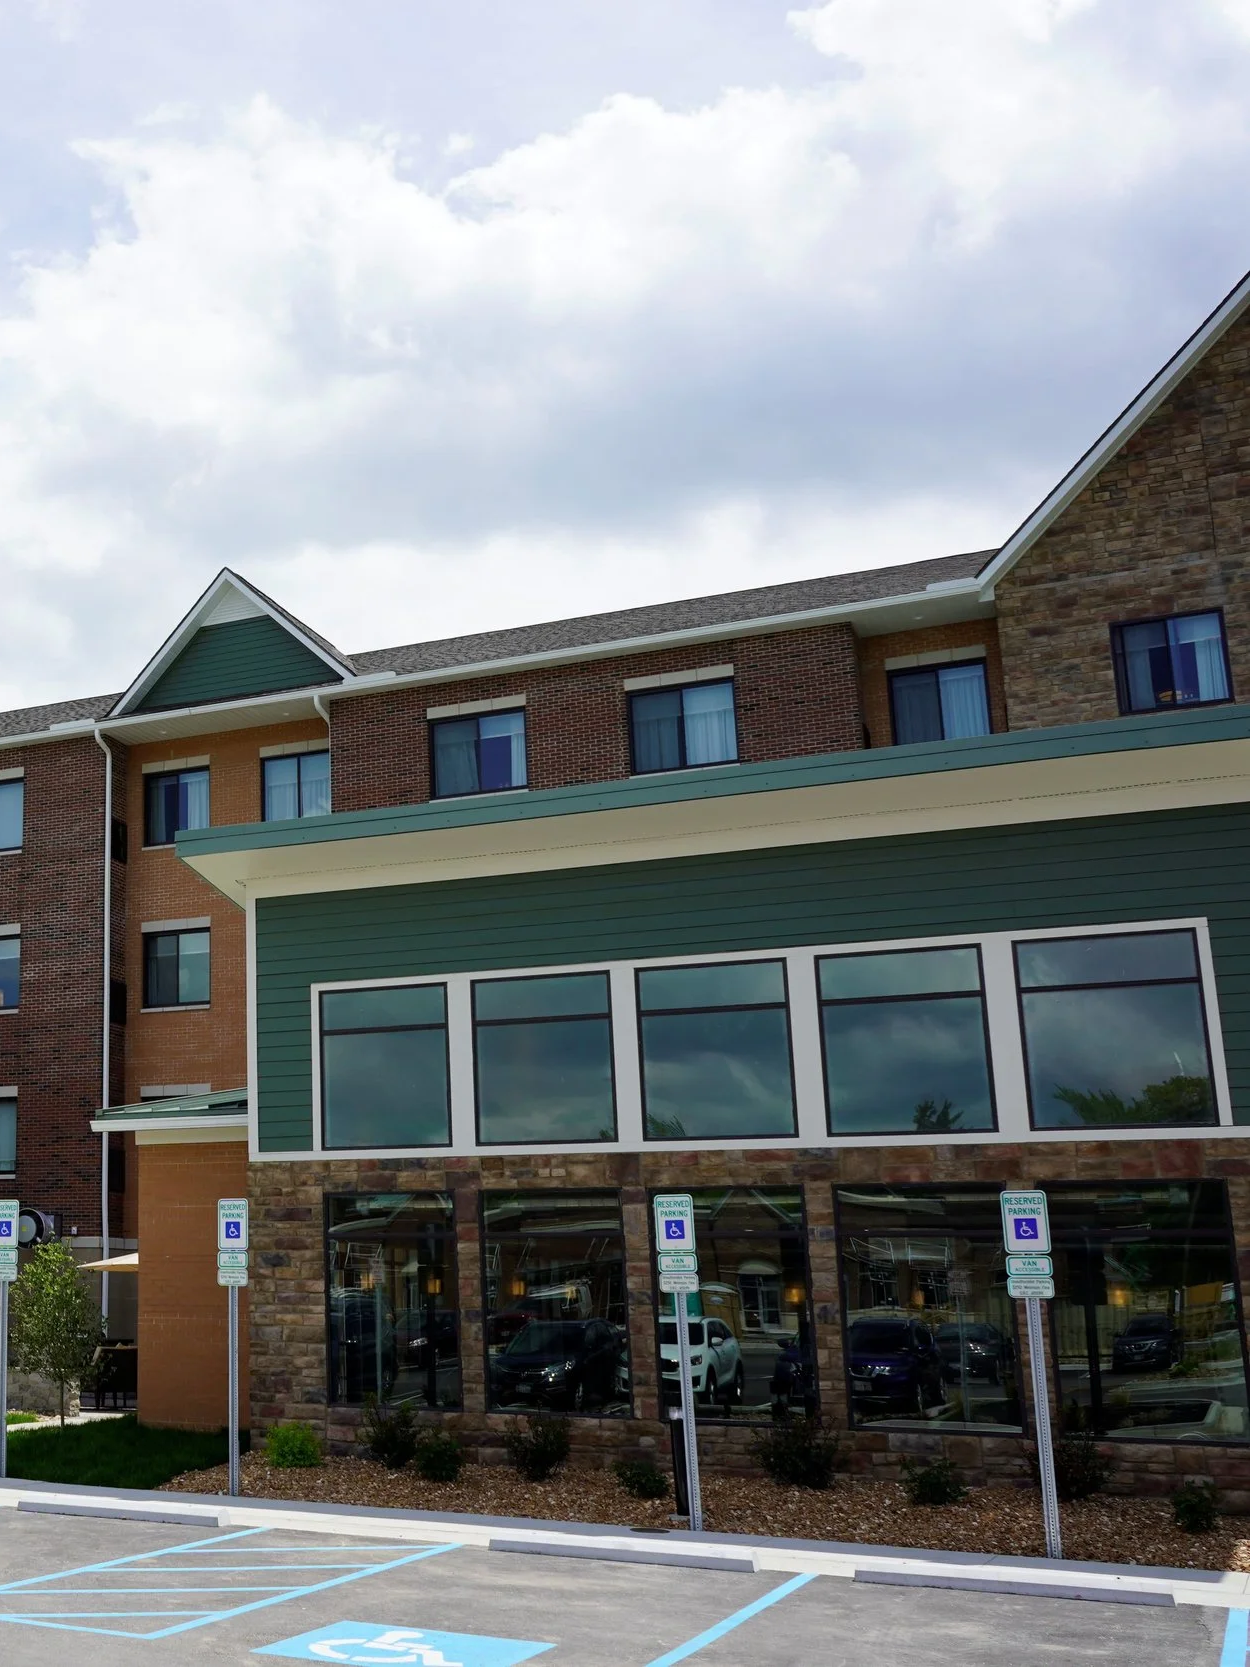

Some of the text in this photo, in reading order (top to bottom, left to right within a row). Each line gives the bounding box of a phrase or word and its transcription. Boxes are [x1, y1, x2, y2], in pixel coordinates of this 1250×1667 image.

[657, 1200, 690, 1208] RESERVED
[1004, 1197, 1043, 1205] RESERVED
[220, 1203, 246, 1211] RESERVED
[660, 1209, 688, 1218] PARKING
[1008, 1207, 1042, 1216] PARKING
